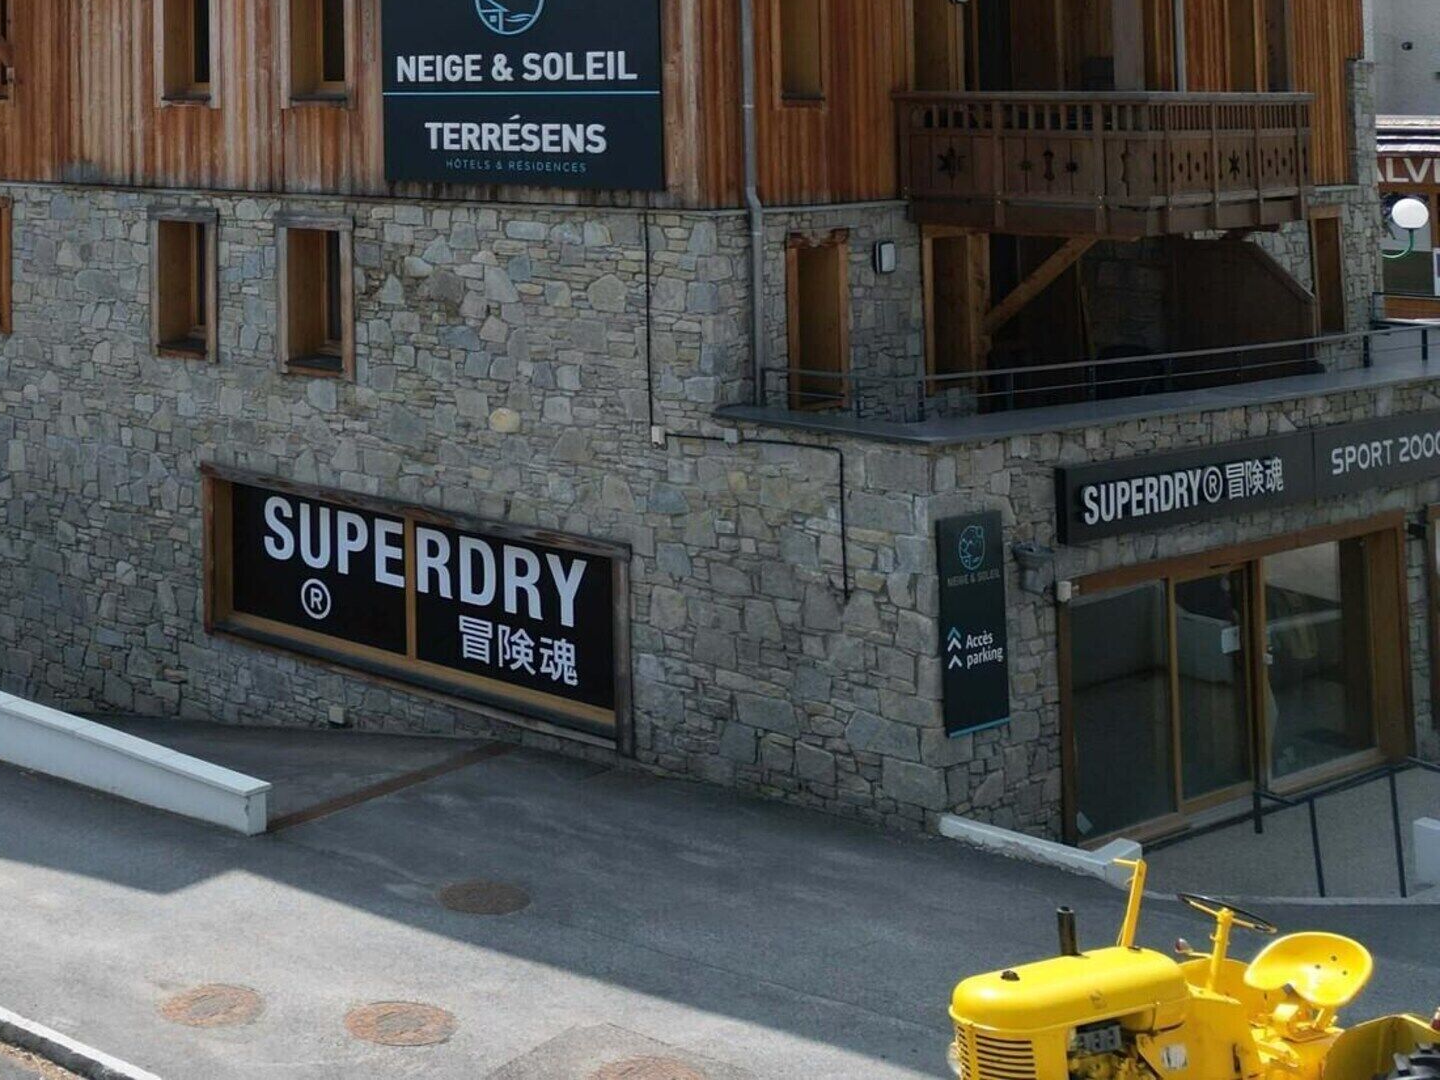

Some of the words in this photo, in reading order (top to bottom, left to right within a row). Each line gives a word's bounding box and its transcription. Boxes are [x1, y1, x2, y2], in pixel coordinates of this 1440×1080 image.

[397, 55, 482, 82] NEIGE
[491, 53, 514, 81] &
[522, 51, 638, 81] SOLEIL
[424, 114, 607, 154] TERRÉSENS
[1331, 440, 1393, 475] SPORT
[263, 496, 588, 628] SUPERDRY
[459, 615, 578, 687] 冒険魂
[965, 630, 993, 649] Accès
[966, 646, 1003, 669] parking
